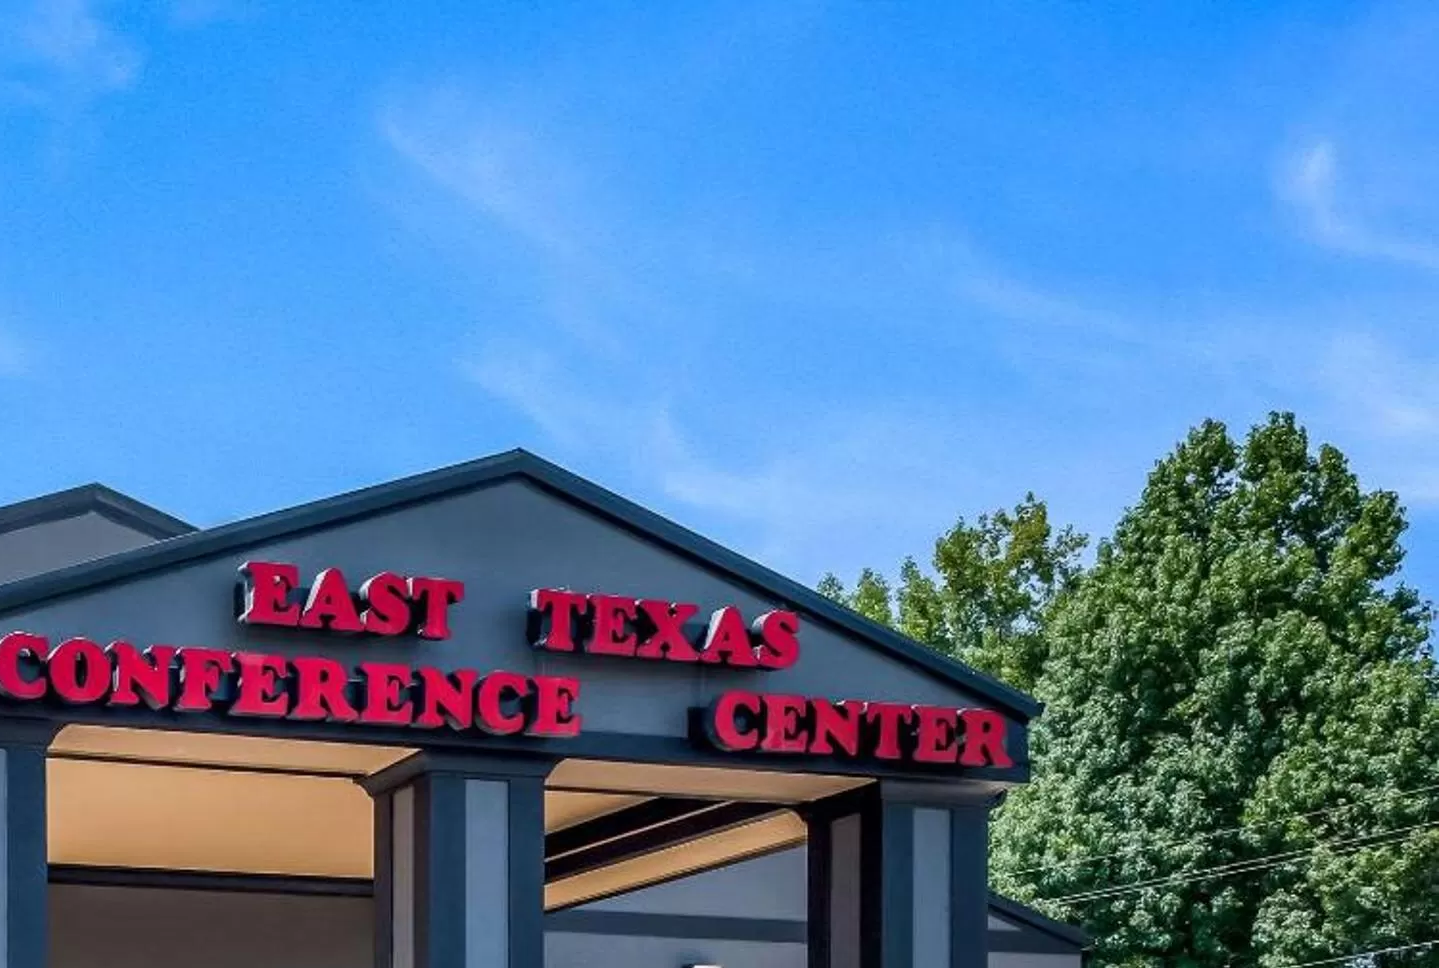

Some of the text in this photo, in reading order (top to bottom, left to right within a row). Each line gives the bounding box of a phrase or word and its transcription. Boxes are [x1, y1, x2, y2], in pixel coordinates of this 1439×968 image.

[244, 562, 800, 669] EAST TEXAS
[713, 690, 1013, 768] CENTER
